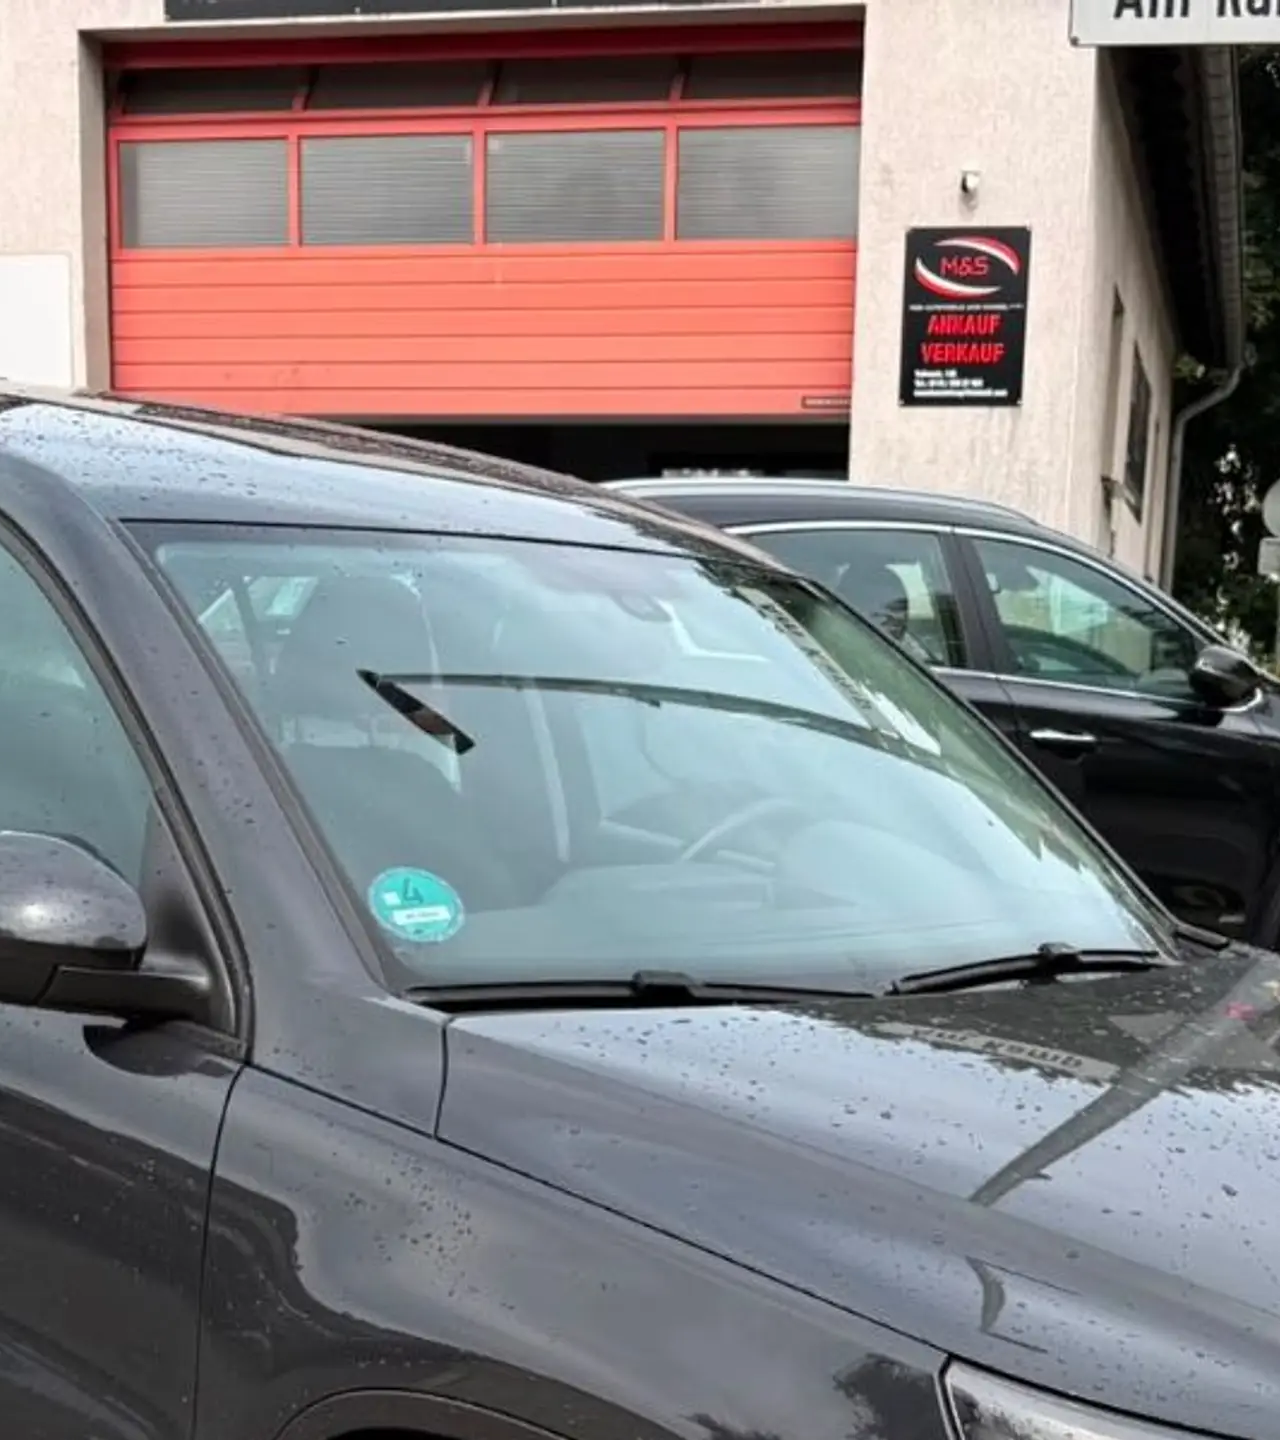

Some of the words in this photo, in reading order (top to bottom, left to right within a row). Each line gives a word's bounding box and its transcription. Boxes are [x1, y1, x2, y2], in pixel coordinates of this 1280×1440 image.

[939, 255, 990, 277] M&S
[926, 313, 1002, 335] ANKAUF
[920, 341, 1005, 364] VERKAUF
[402, 876, 424, 904] 4
